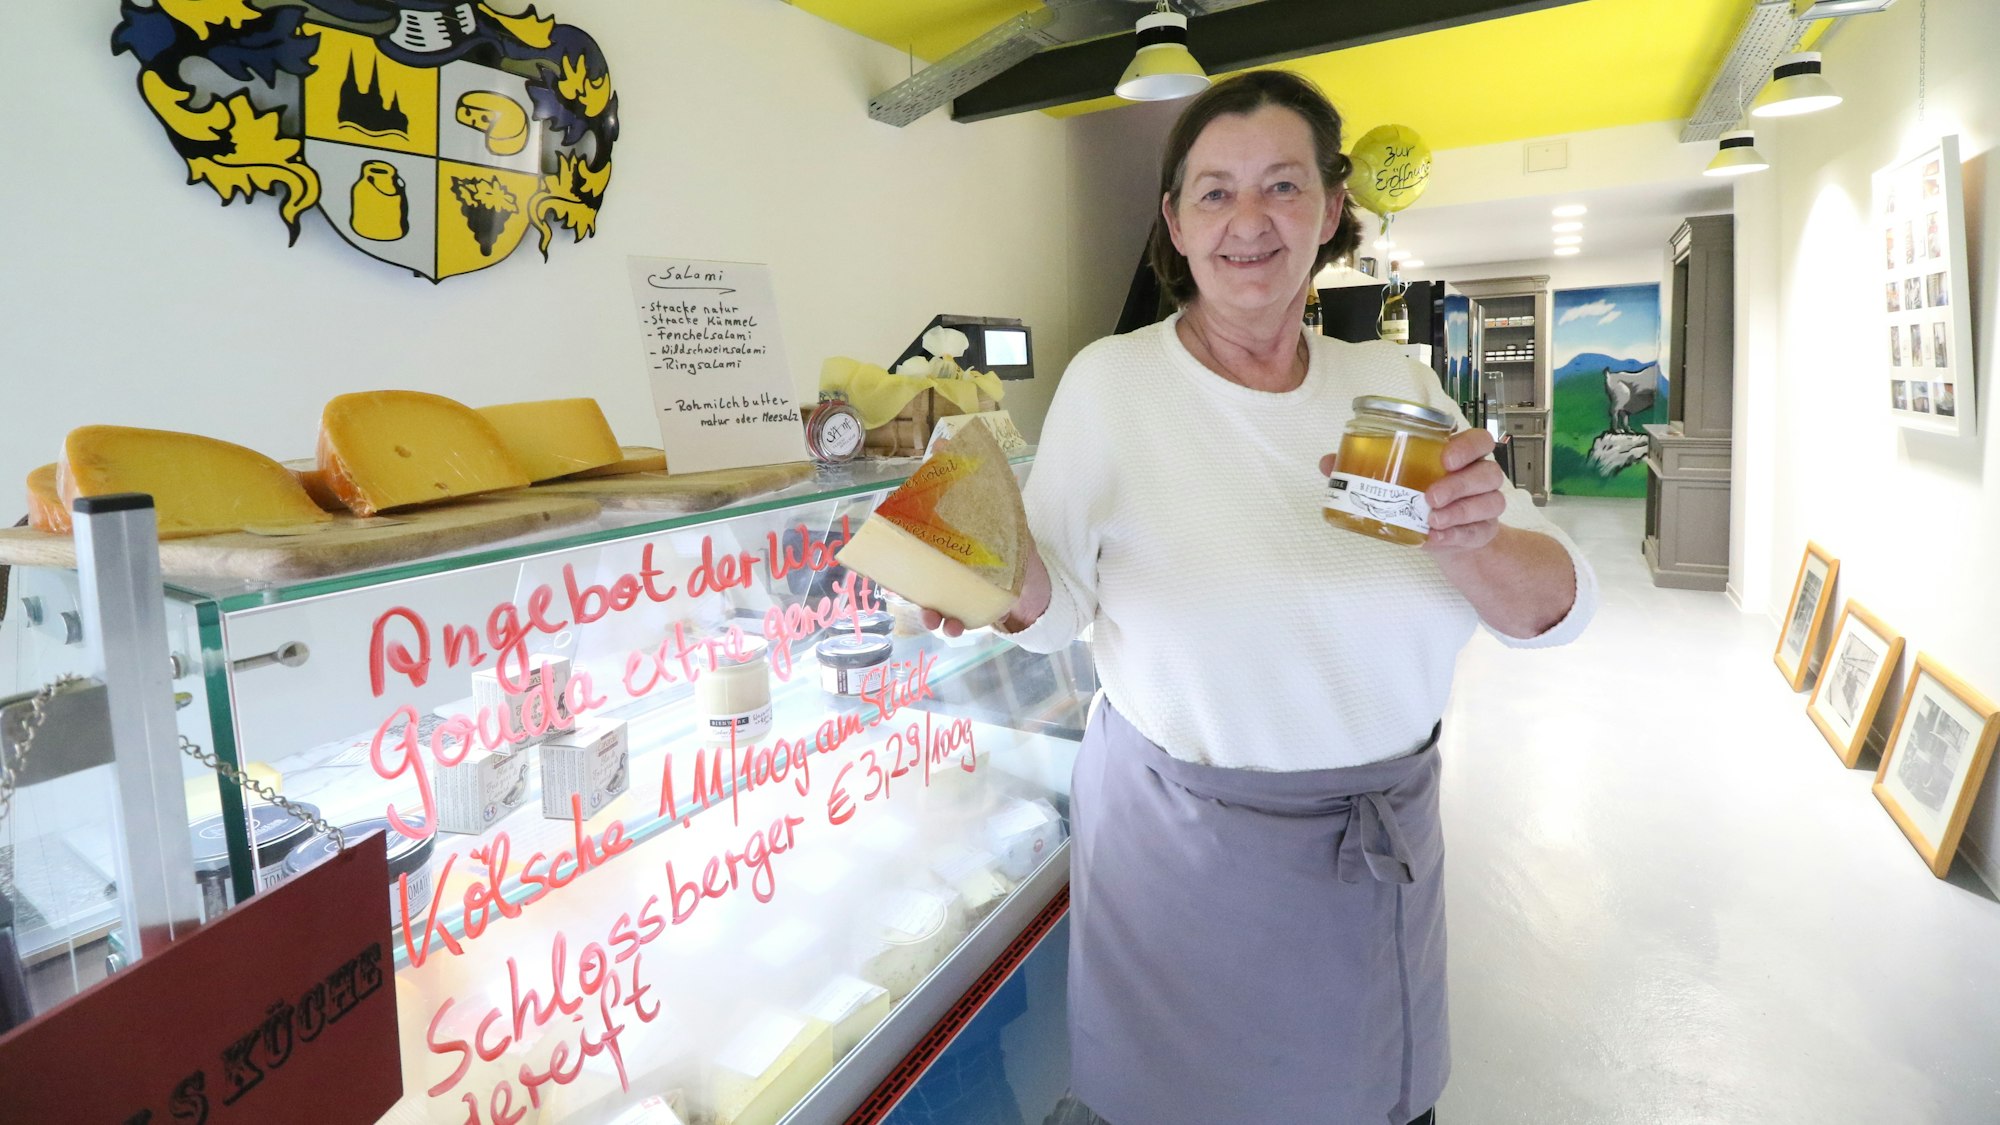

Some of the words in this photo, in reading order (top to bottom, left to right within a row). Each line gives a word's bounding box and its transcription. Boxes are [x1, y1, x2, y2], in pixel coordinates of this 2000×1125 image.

[1383, 145, 1416, 168] zur
[659, 265, 724, 282] Salami
[703, 301, 739, 314] natur
[707, 315, 758, 327] Kümmel
[657, 326, 752, 341] Fenchelsalami
[661, 342, 766, 355] Wildschweinsalami
[662, 357, 742, 375] Ringsalami
[675, 392, 789, 412] Rohmilchbutter
[735, 413, 758, 424] oder
[369, 542, 677, 697] Angebot
[687, 535, 760, 598] der
[622, 619, 754, 698] extra
[763, 571, 880, 682] gereift
[399, 792, 634, 968] Kölsche
[815, 715, 864, 754] am
[860, 648, 938, 727] Stück
[427, 814, 804, 1097] Schlossberger
[221, 942, 384, 1107] KÜCHE
